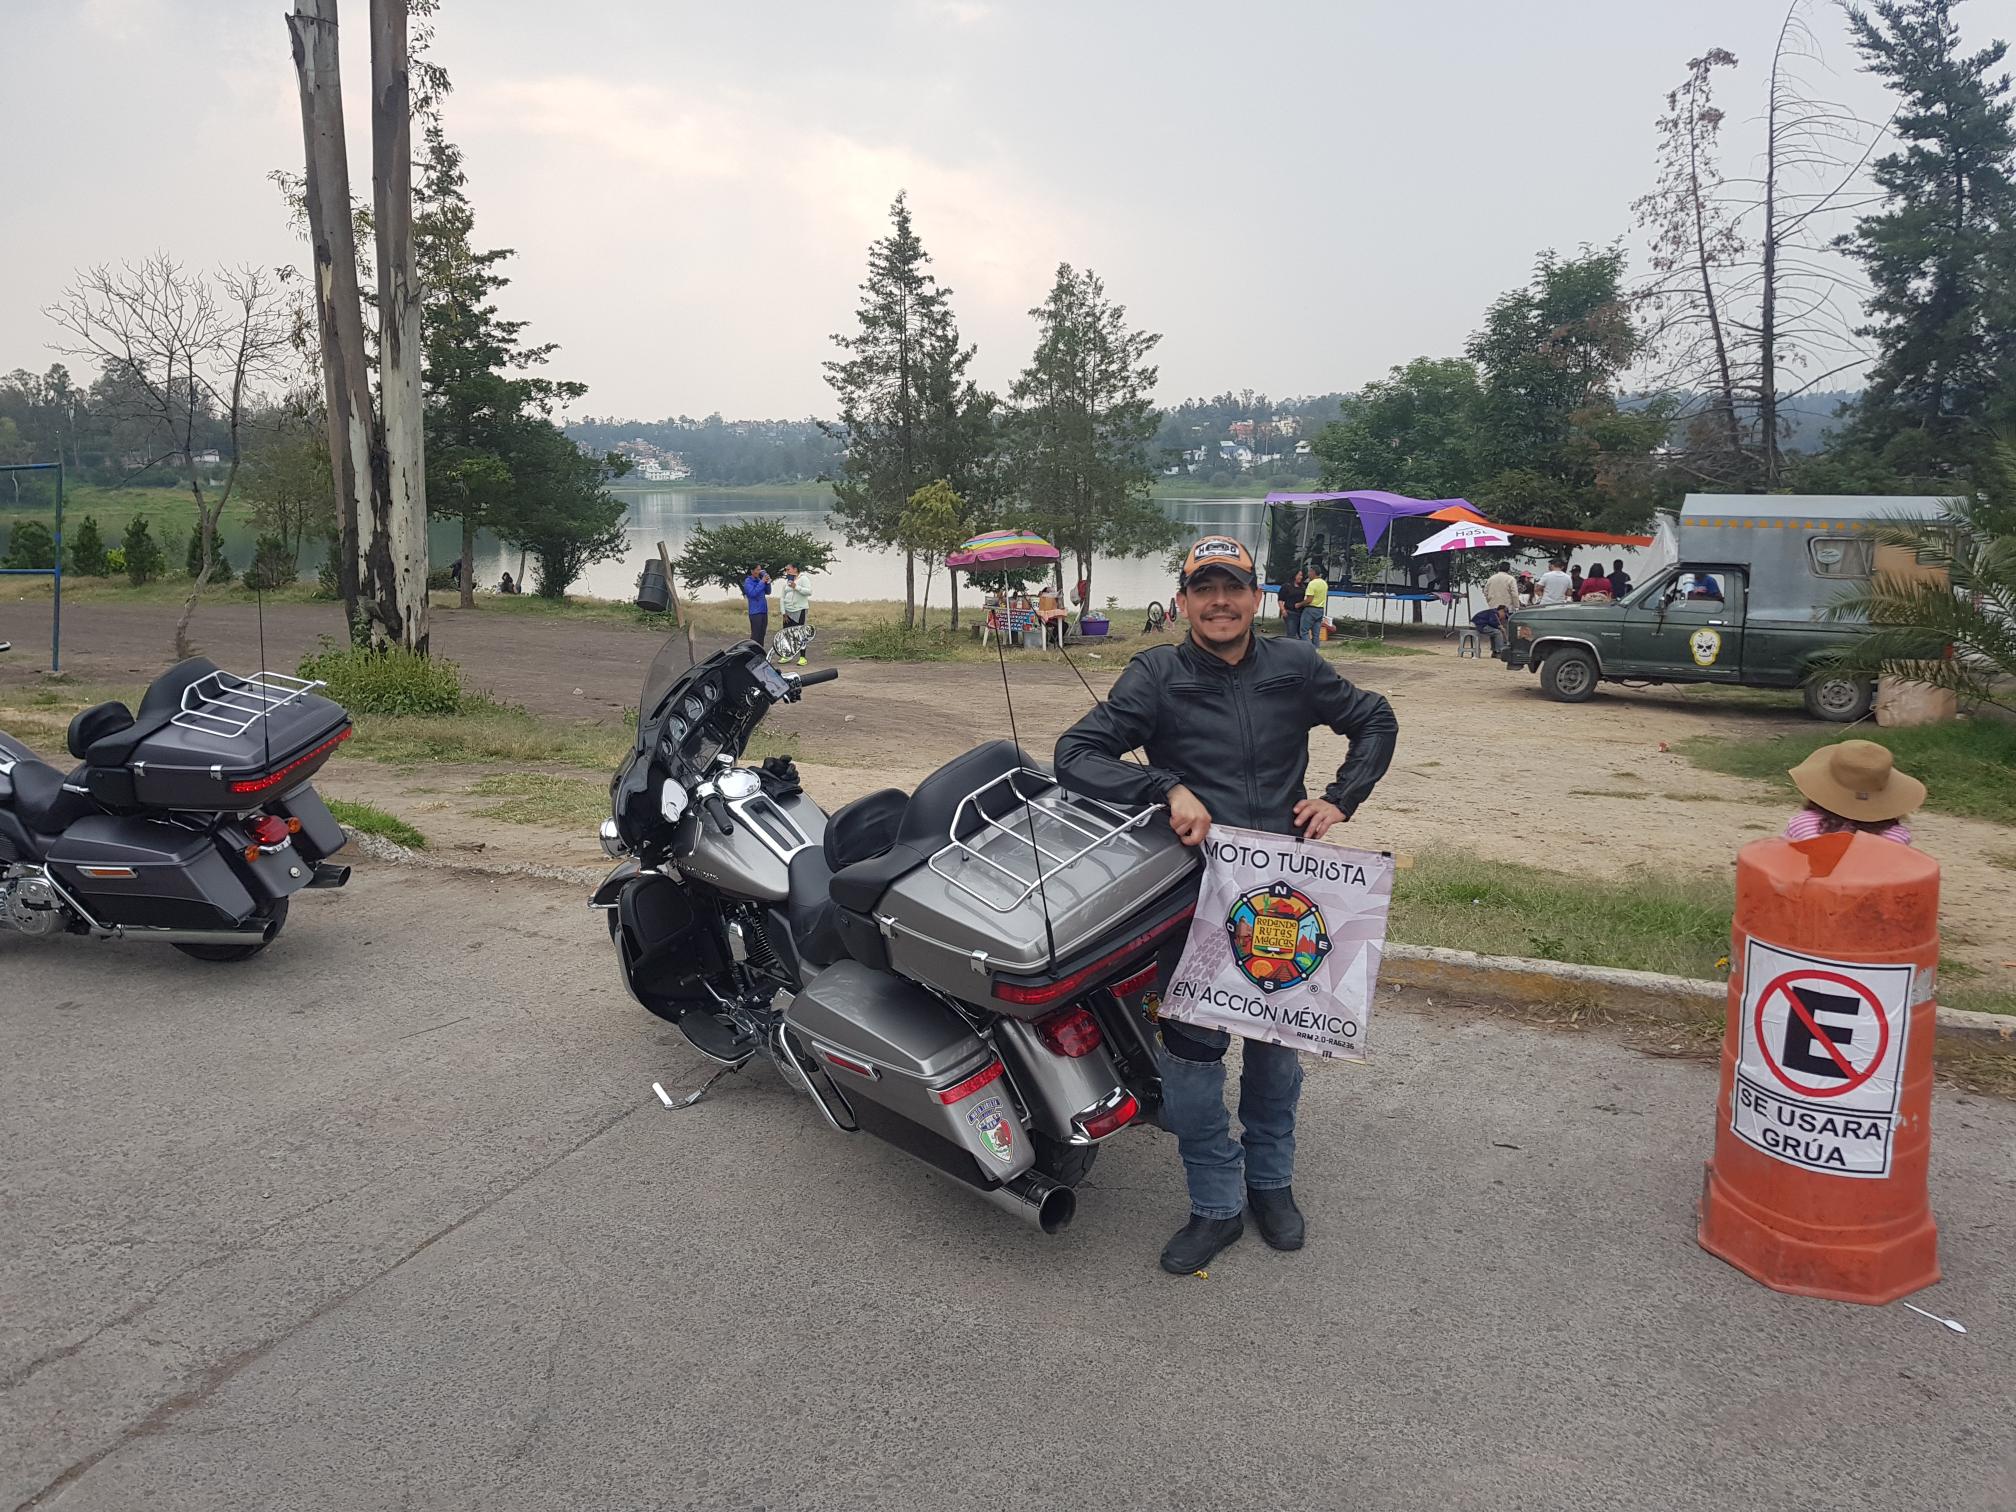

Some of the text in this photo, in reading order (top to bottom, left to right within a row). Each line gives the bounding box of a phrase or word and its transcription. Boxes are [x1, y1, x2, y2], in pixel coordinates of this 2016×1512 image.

[1204, 840, 1366, 886] MOTO TURISTA
[1274, 886, 1287, 895] N
[1318, 940, 1328, 950] E
[1263, 980, 1274, 990] S
[1172, 981, 1357, 1038] EN ACCIÓN MÉXICO
[1740, 1087, 1882, 1141] SE USARA
[1762, 1128, 1847, 1167] GRÚA
